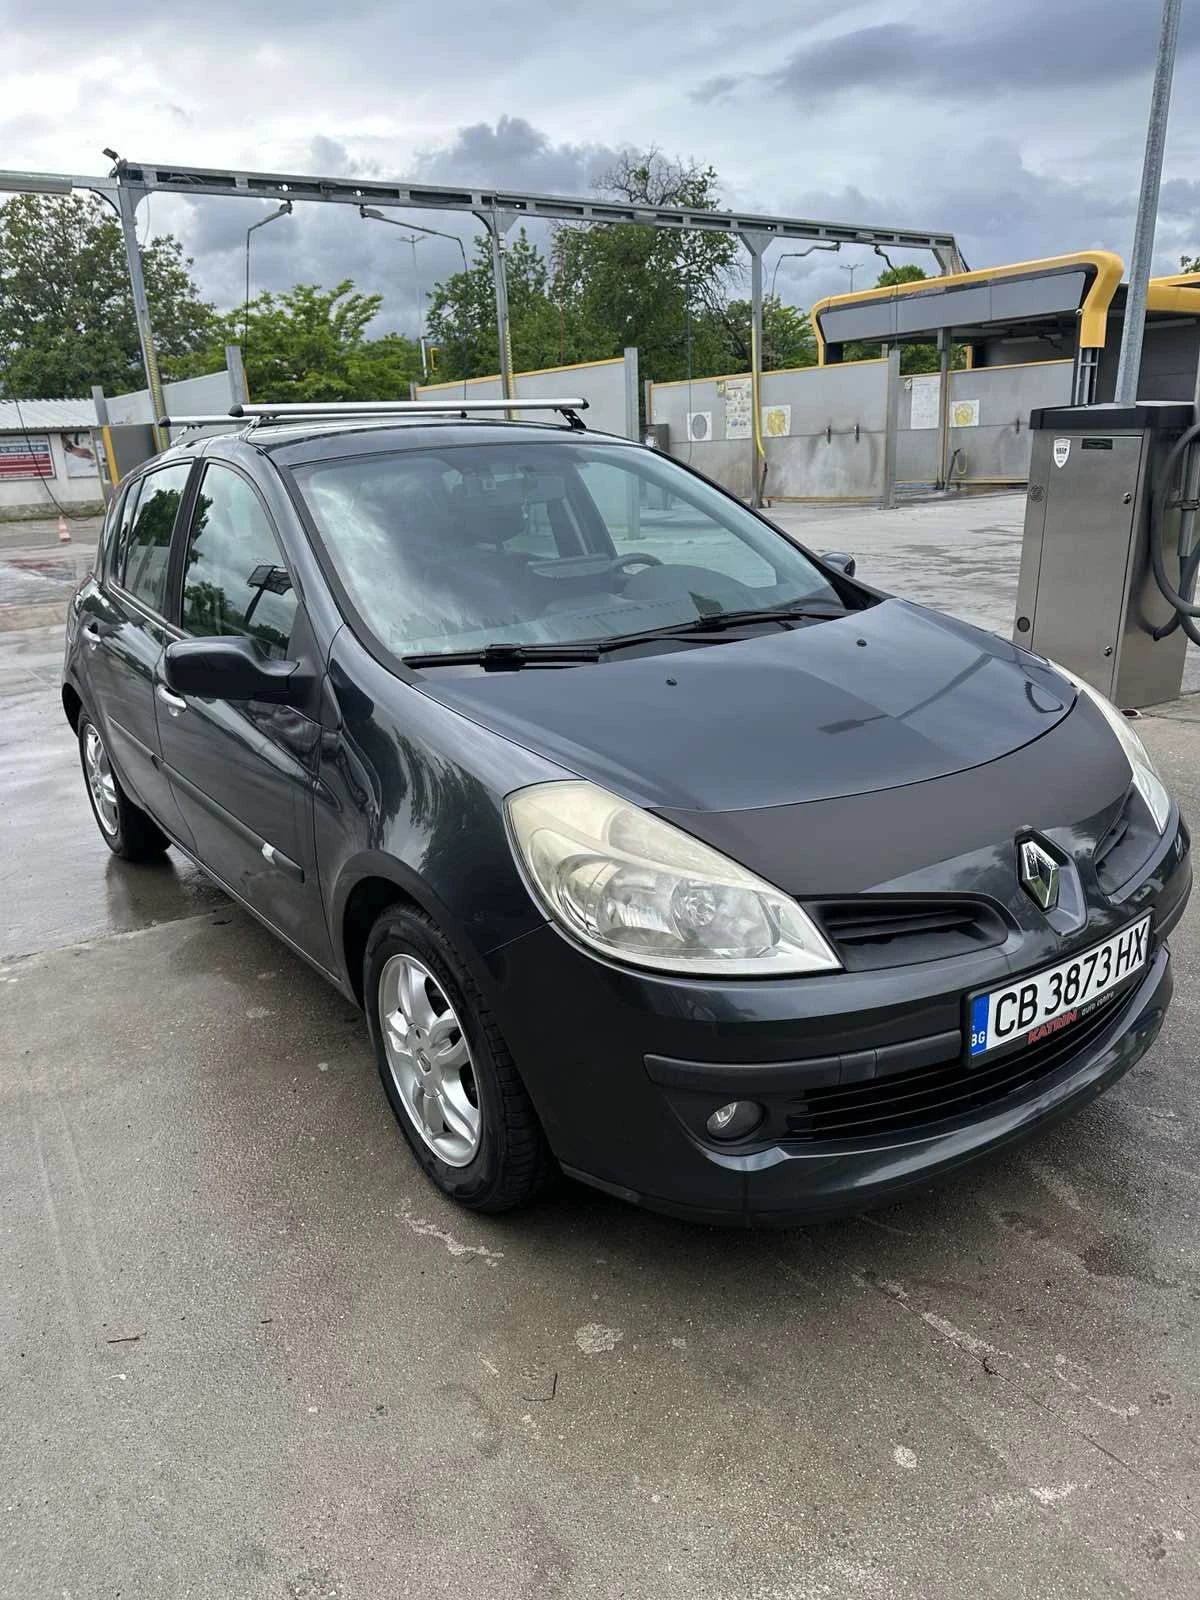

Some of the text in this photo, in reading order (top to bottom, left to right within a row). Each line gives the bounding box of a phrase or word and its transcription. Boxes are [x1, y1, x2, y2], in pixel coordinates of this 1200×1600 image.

[995, 922, 1147, 1037] CB 3873 HX
[971, 1031, 986, 1047] BG
[1027, 1007, 1078, 1044] KATRIN
